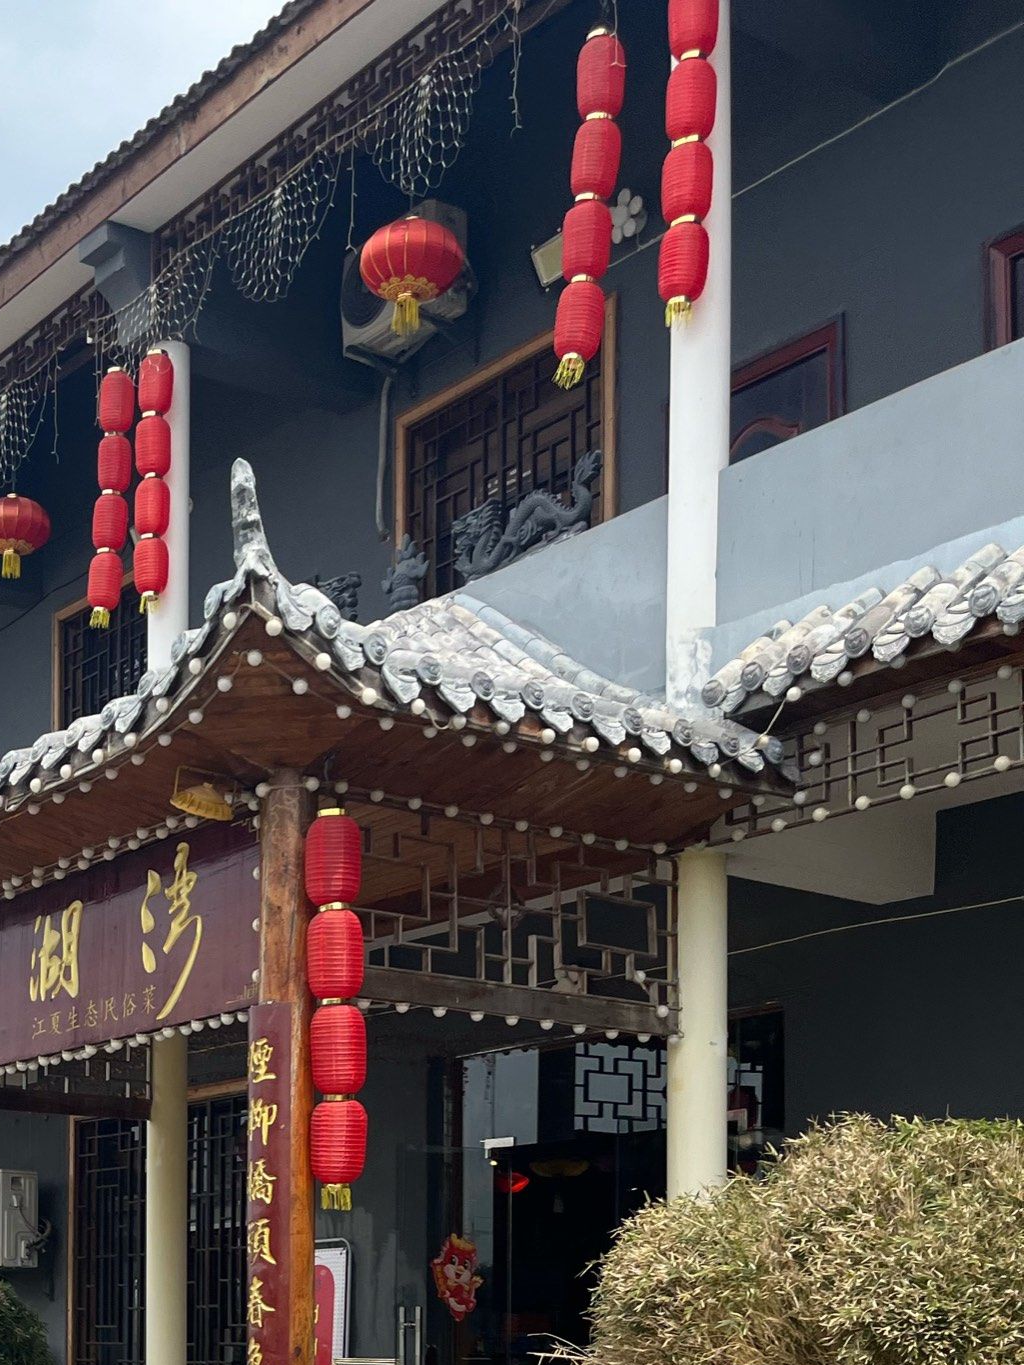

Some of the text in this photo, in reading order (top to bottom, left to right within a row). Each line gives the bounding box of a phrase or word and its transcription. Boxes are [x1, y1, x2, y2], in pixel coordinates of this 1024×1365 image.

[31, 984, 158, 1040] 江夏生态民俗菜
